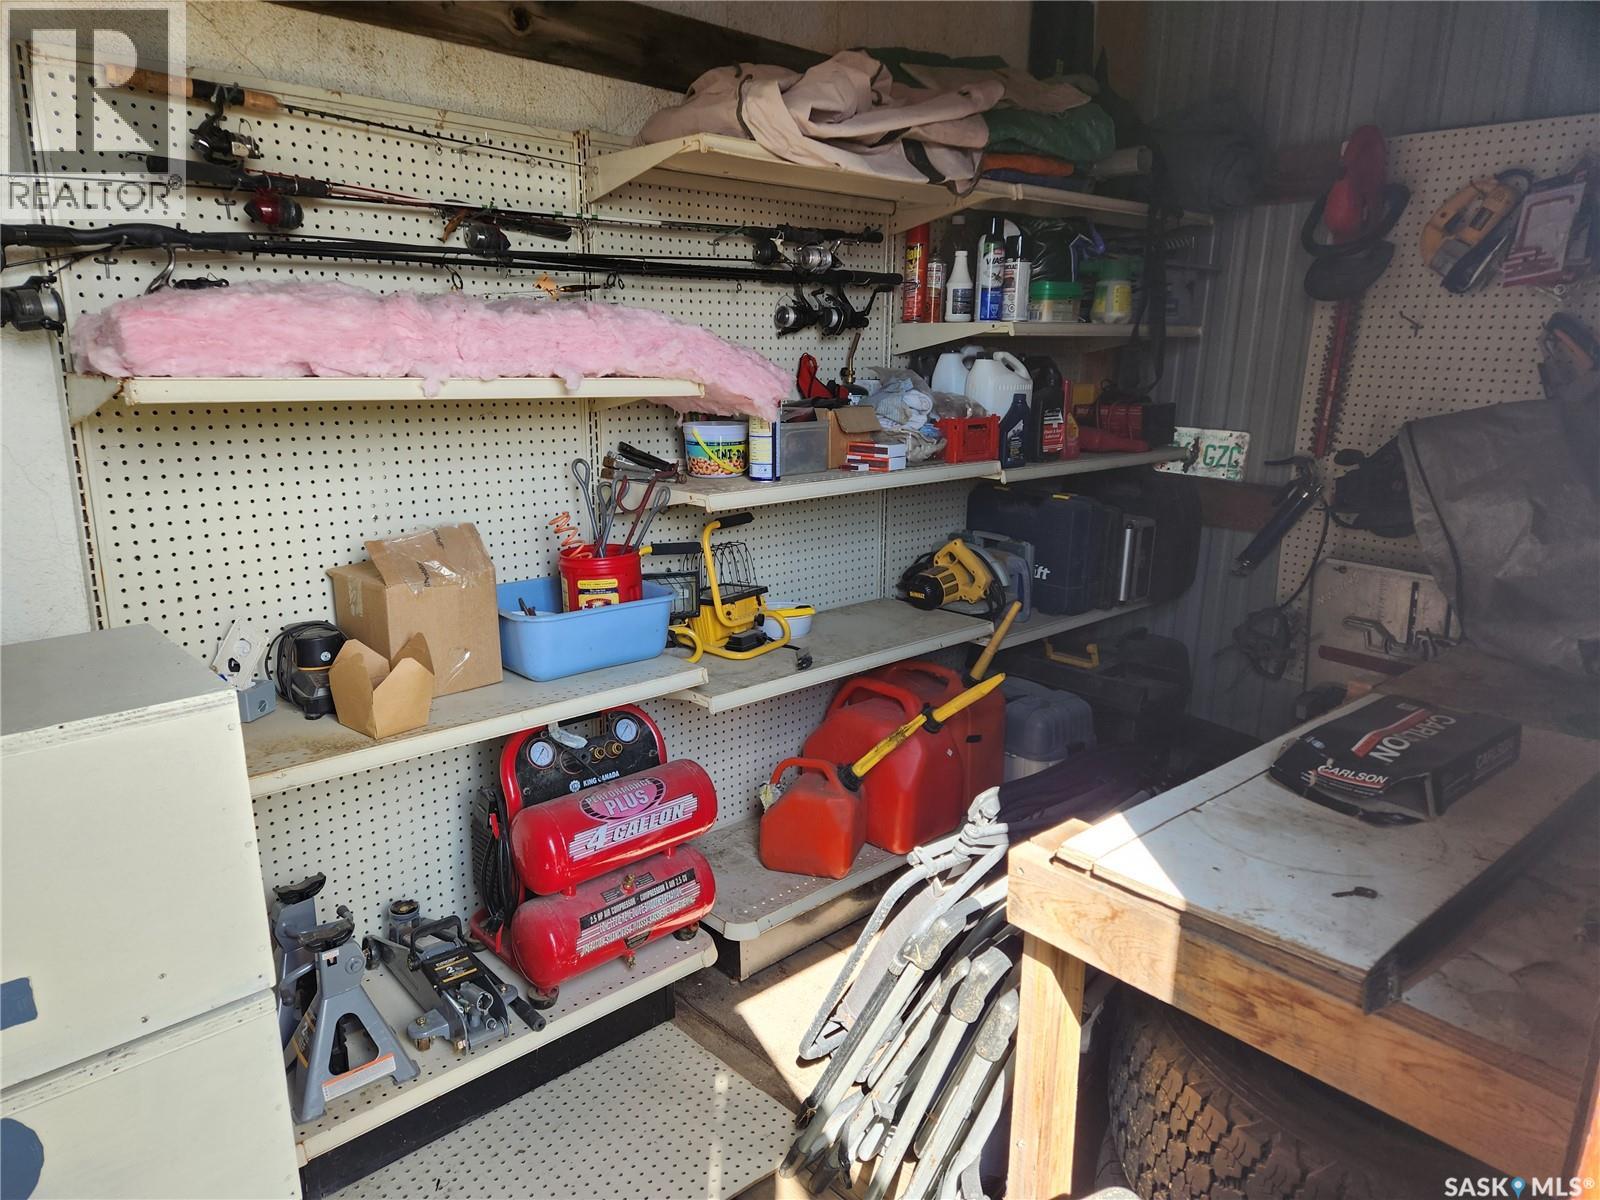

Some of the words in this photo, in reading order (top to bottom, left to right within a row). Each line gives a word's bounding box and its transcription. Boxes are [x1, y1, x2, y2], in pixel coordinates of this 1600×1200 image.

[583, 777, 598, 787] KING
[1317, 764, 1389, 784] CARLSON
[585, 778, 653, 804] PERFORMANCE
[604, 789, 649, 816] PLUS
[585, 824, 609, 851] 4
[612, 803, 686, 842] GALLON
